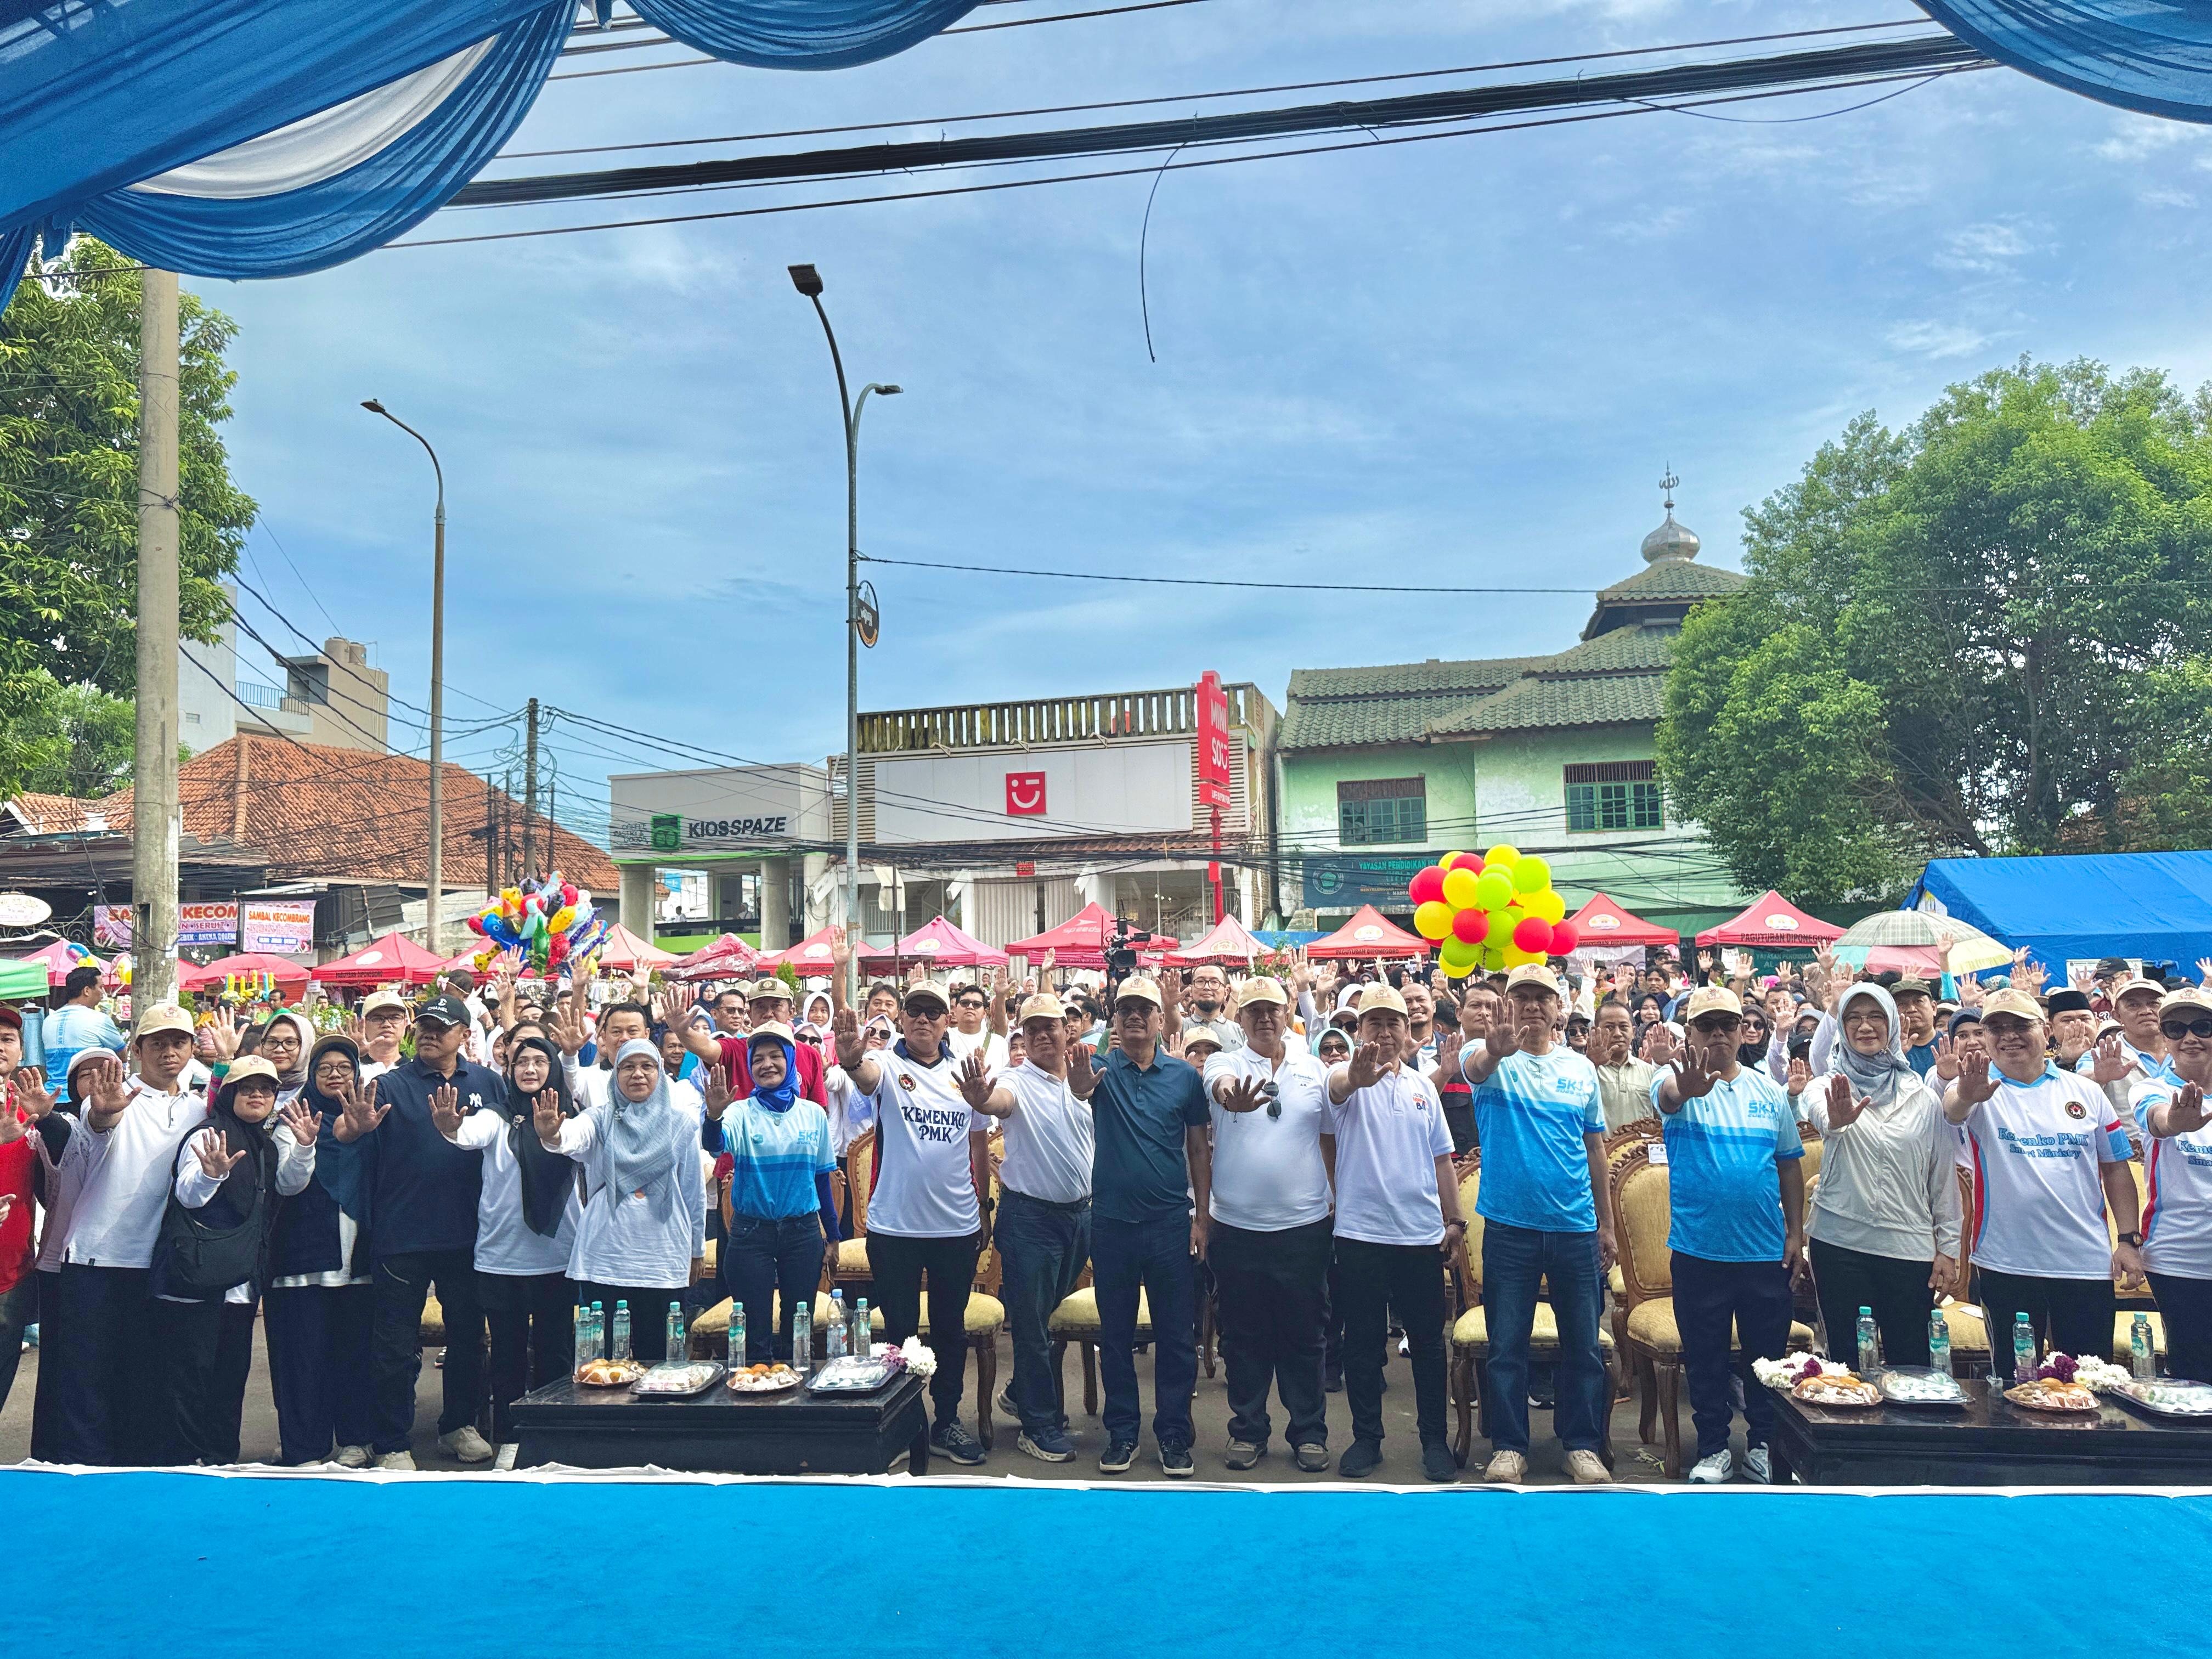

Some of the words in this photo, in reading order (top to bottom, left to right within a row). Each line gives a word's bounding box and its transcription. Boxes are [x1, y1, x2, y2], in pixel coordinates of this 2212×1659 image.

[1210, 698, 1227, 735] MINI
[689, 816, 787, 838] KIOSSPAZE
[1359, 861, 1387, 870] YAYASAN
[249, 911, 271, 921] SAMBAL
[273, 913, 310, 923] KECOMBRANG
[901, 1106, 965, 1130] KEMENKO
[918, 1125, 952, 1144] PMK
[2058, 1132, 2089, 1147] PMK
[2010, 1143, 2036, 1158] Smrt
[2036, 1148, 2081, 1159] Ministry
[2176, 1139, 2212, 1154] Keme
[2188, 1155, 2212, 1166] Sma
